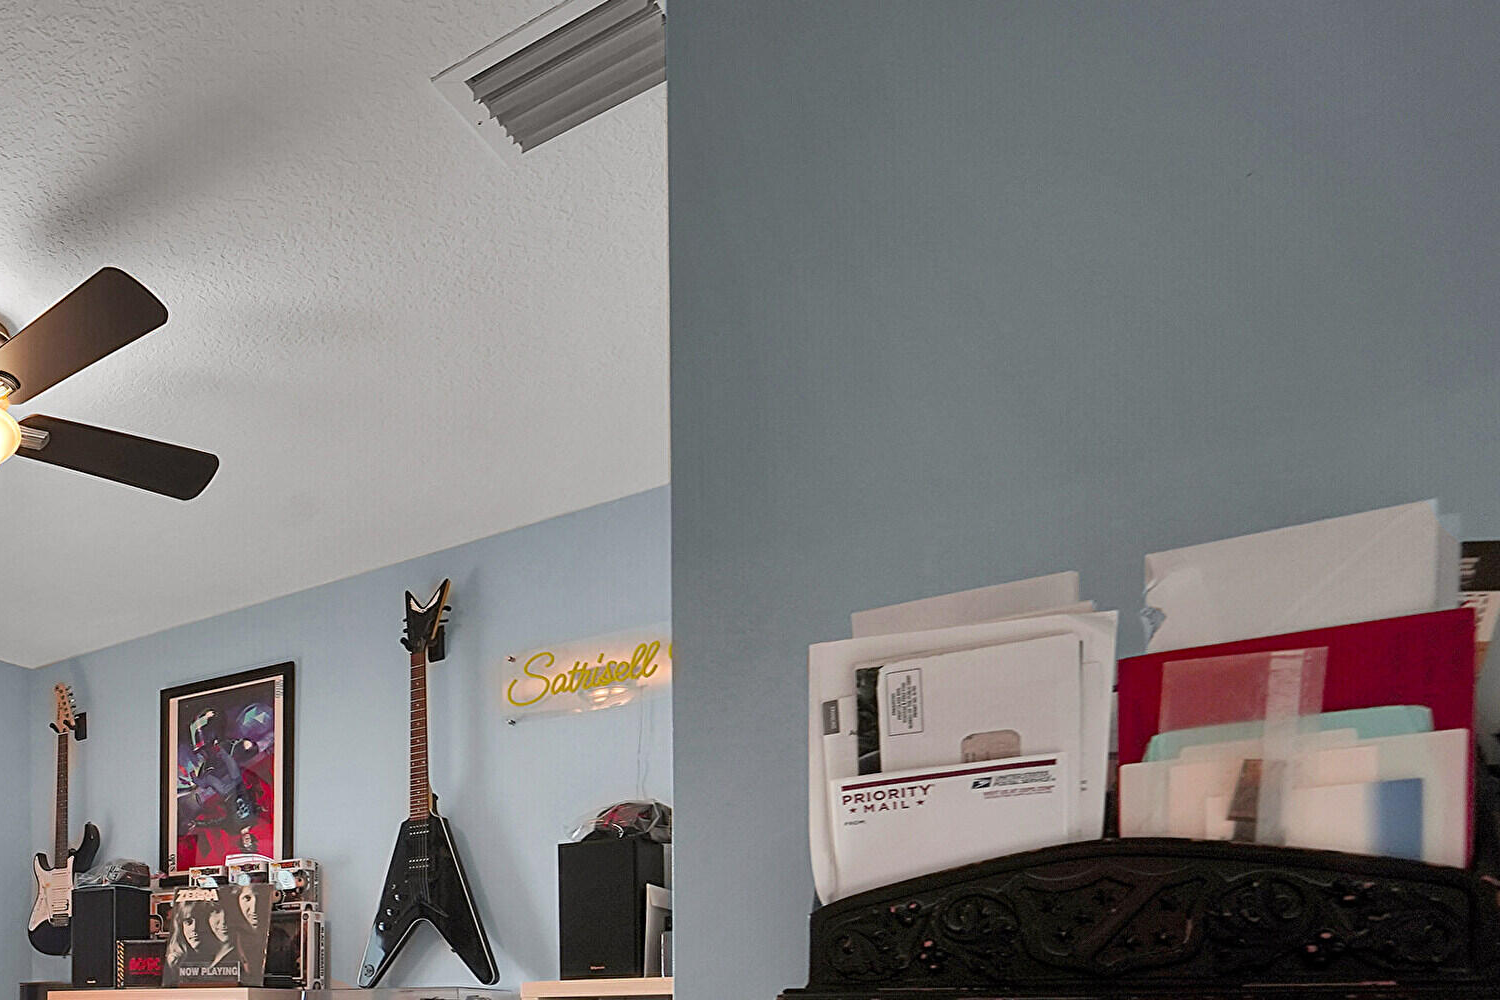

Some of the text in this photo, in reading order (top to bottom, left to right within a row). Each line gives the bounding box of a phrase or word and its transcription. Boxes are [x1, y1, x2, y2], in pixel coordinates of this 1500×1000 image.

[507, 640, 660, 707] Satrisell
[842, 784, 932, 805] PRIORITY
[863, 801, 910, 813] MAIL
[179, 966, 238, 977] NOW PLAYING
